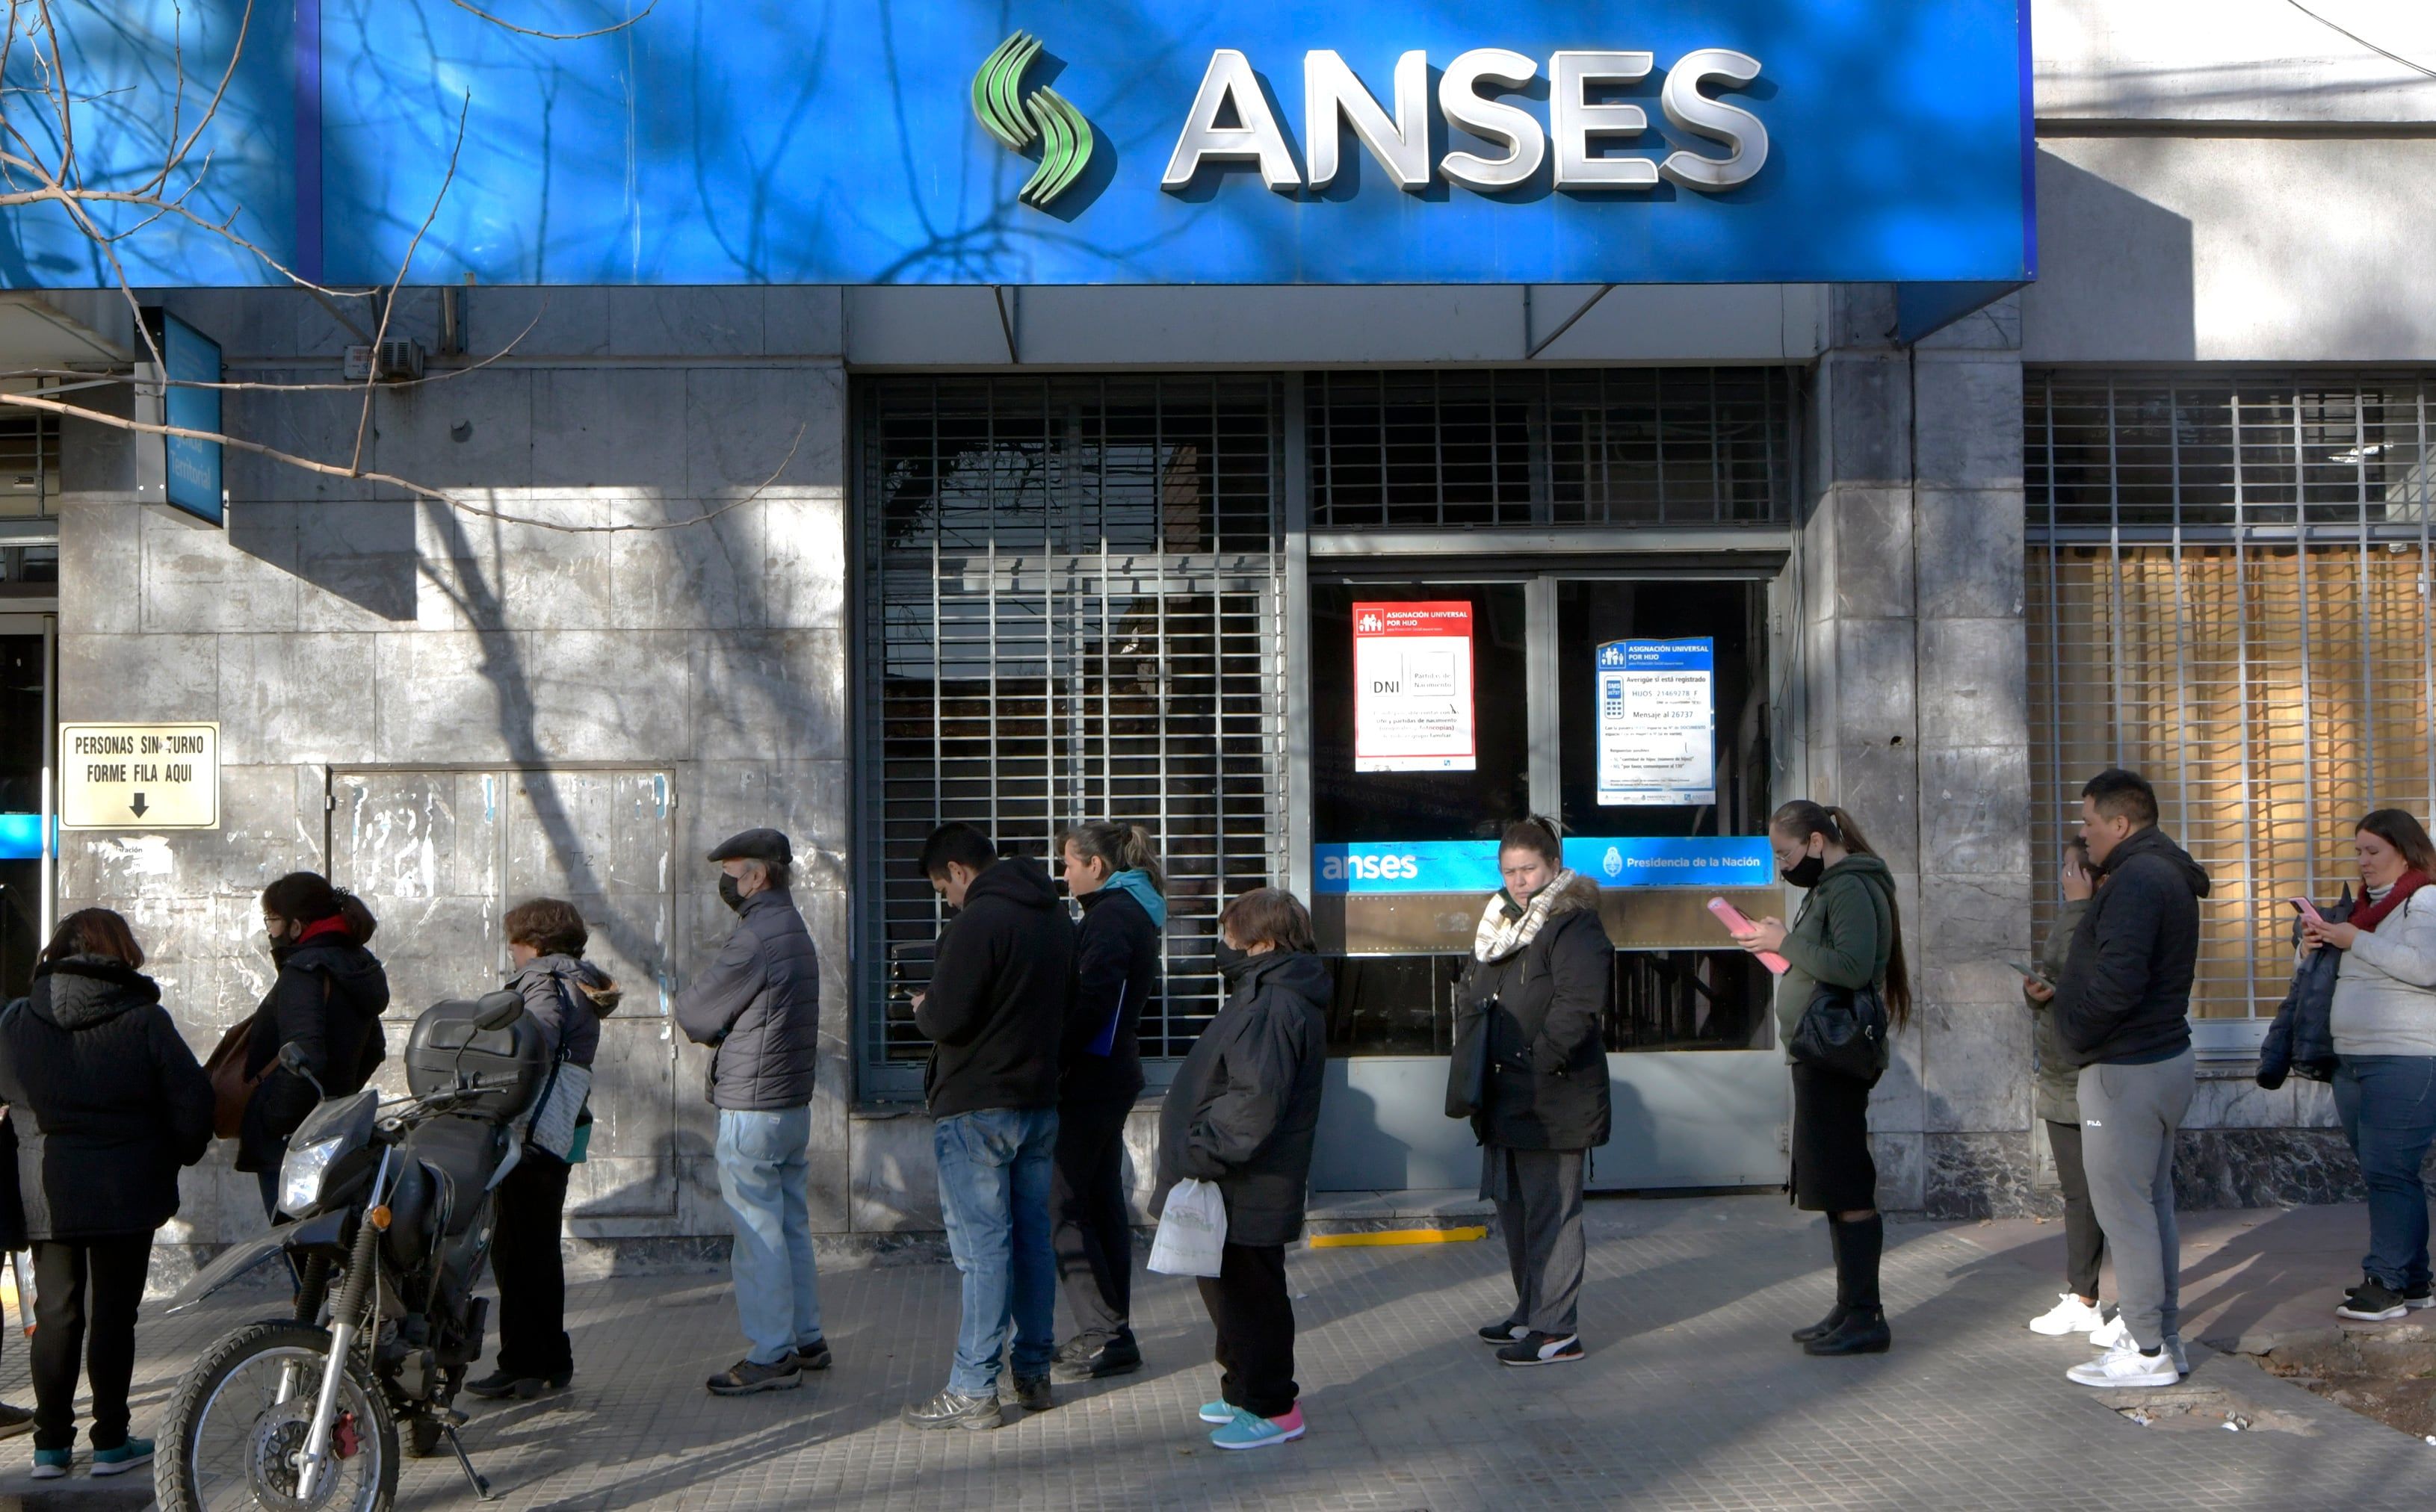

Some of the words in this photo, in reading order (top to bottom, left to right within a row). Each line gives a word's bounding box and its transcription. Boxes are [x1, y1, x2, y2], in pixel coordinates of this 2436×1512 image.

[1161, 48, 1769, 192] ANSES
[170, 449, 211, 491] Territorial
[1386, 610, 1429, 619] ASIGNACIÓN
[1373, 681, 1400, 693] DNI
[1627, 676, 1653, 684] Averigüe
[1675, 675, 1707, 684] registrado
[1633, 710, 1661, 719] Mensaje
[1671, 710, 1693, 719] 26737
[75, 735, 134, 755] PERSONAS
[140, 735, 159, 755] SIN
[166, 735, 204, 754] TURNO
[87, 763, 126, 783] FORME
[134, 763, 158, 782] FILA
[165, 763, 192, 784] AQUI
[1322, 850, 1418, 880] anses
[1627, 857, 1690, 867] Presidencia
[1692, 857, 1707, 867] de
[1709, 856, 1719, 867] la
[1722, 855, 1760, 867] Nación
